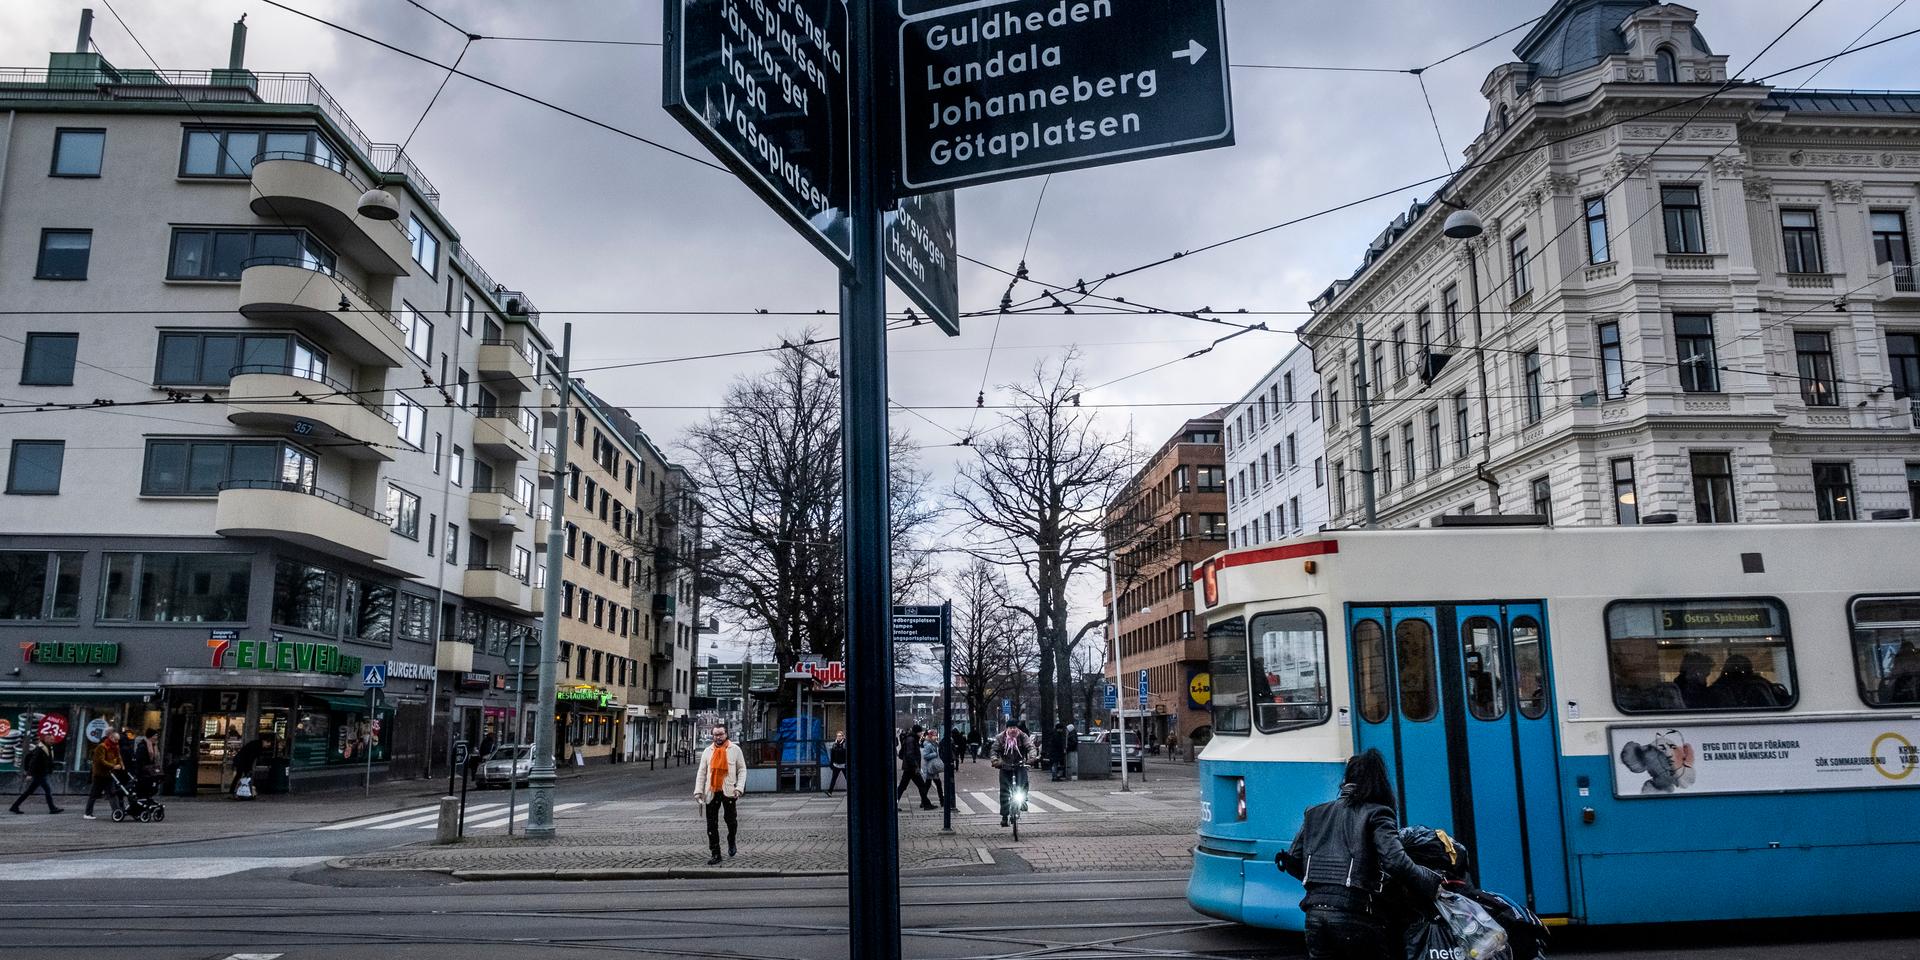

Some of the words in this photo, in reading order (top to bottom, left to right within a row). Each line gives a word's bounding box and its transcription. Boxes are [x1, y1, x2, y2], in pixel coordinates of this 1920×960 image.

[926, 0, 1112, 51] Guldheden
[721, 33, 767, 114] Haga
[927, 44, 1061, 90] Landala
[929, 69, 1157, 129] Johanneberg
[722, 82, 830, 219] Vasaplatsen
[930, 112, 1140, 165] Götaplatsen
[892, 227, 925, 282] Heden
[896, 206, 946, 271] orsvägen
[387, 660, 418, 680] BURGER
[418, 664, 437, 681] KING
[1702, 743, 1720, 751] BYGG
[1722, 742, 1737, 750] DITT
[1738, 742, 1748, 750] CV
[1749, 741, 1763, 750] OCH
[1764, 740, 1800, 749] FÖRÄNDRA
[1703, 753, 1713, 761] EN
[1714, 752, 1737, 761] ANNAN
[1738, 750, 1777, 760] MÄNNISKAS
[1778, 751, 1789, 759] LIV
[1815, 756, 1829, 767] SÖK
[1830, 757, 1875, 766] SOMMARJOBB
[1875, 757, 1886, 765] NU
[1429, 946, 1465, 960] net
